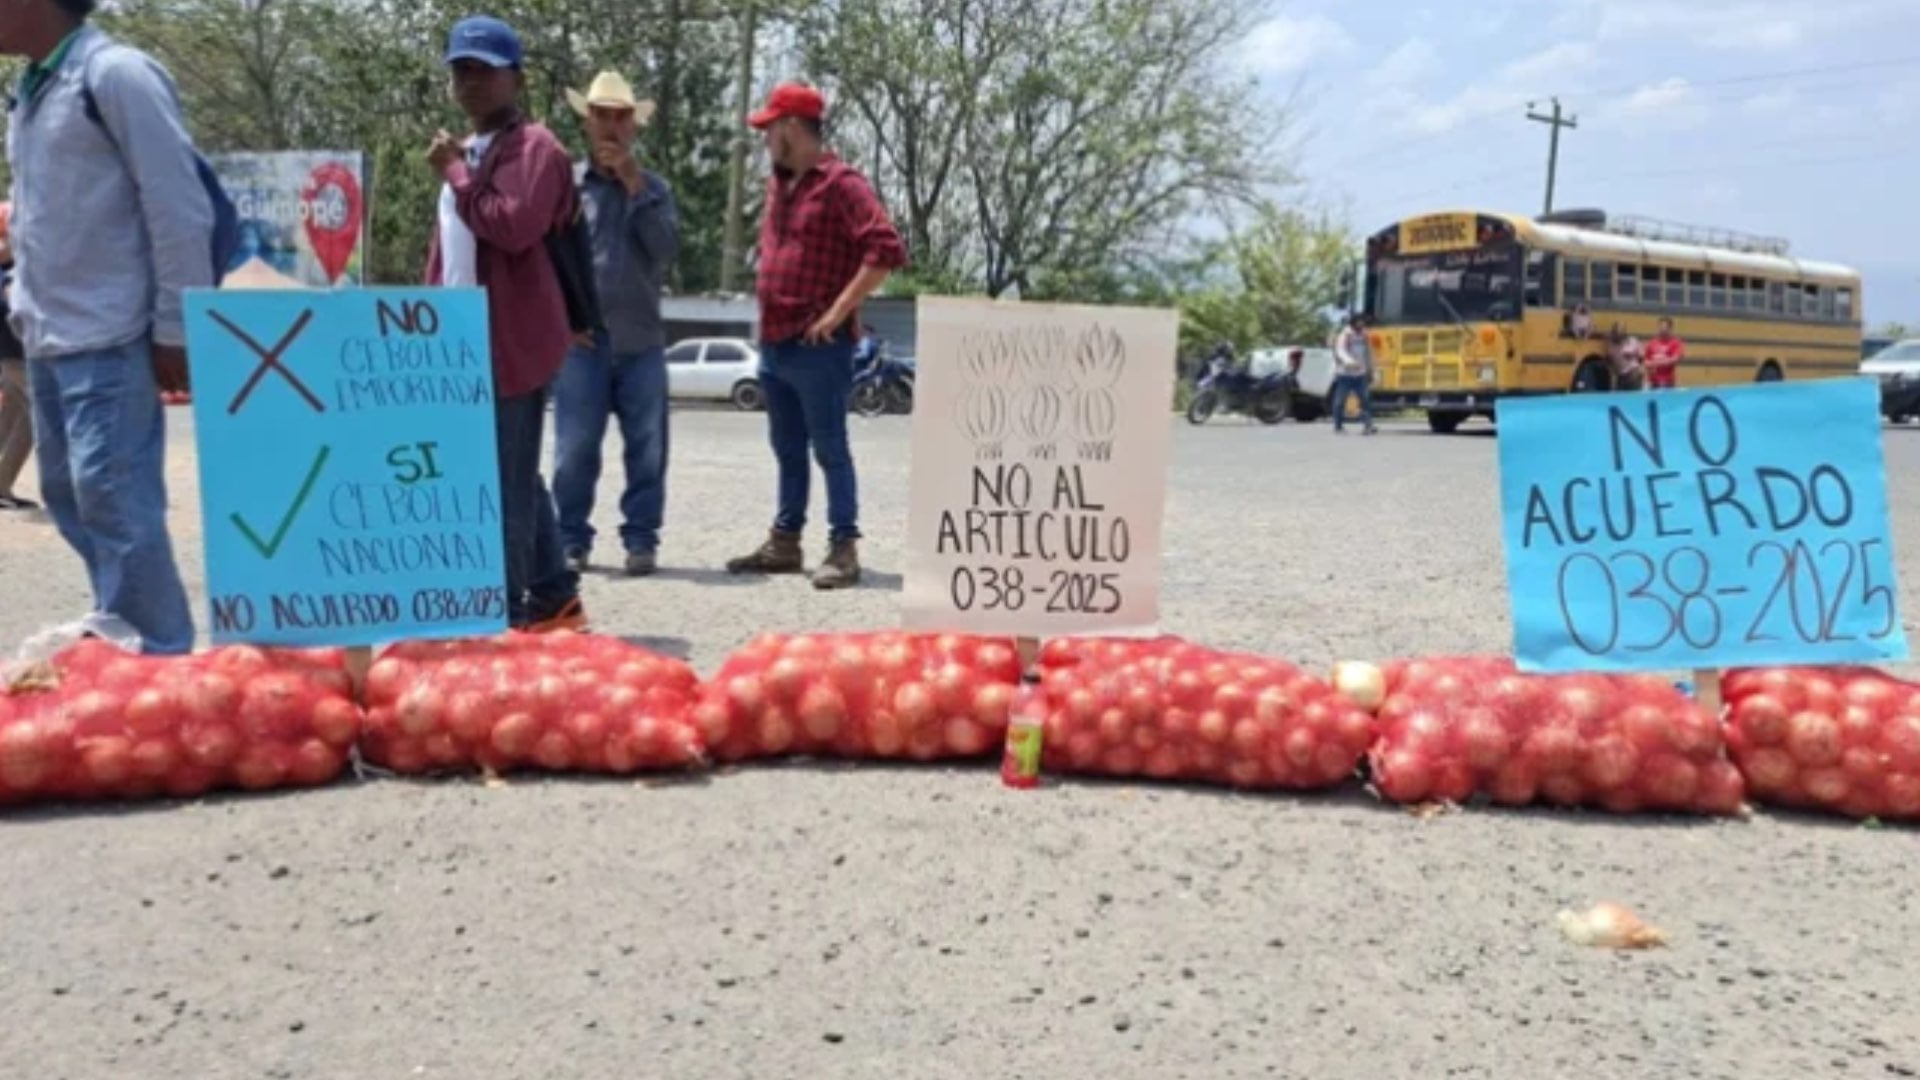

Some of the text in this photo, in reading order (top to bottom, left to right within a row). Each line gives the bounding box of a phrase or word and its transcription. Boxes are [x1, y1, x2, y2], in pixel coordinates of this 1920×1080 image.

[376, 298, 439, 336] NO
[340, 335, 481, 374] CEBOLLA
[334, 374, 490, 412] IMPORTADA
[1608, 394, 1738, 472] NO
[386, 441, 444, 485] SI
[329, 480, 499, 531] CEBOLLA
[972, 463, 1105, 512] NO AL
[1522, 463, 1854, 548] ACUERDO
[317, 532, 497, 577] NACIONAL
[936, 510, 1130, 563] ARTICULO
[211, 592, 256, 633] NO
[270, 590, 400, 631] ACUERDO
[951, 566, 1122, 614] 038-2025
[1556, 537, 1896, 656] 038-2025
